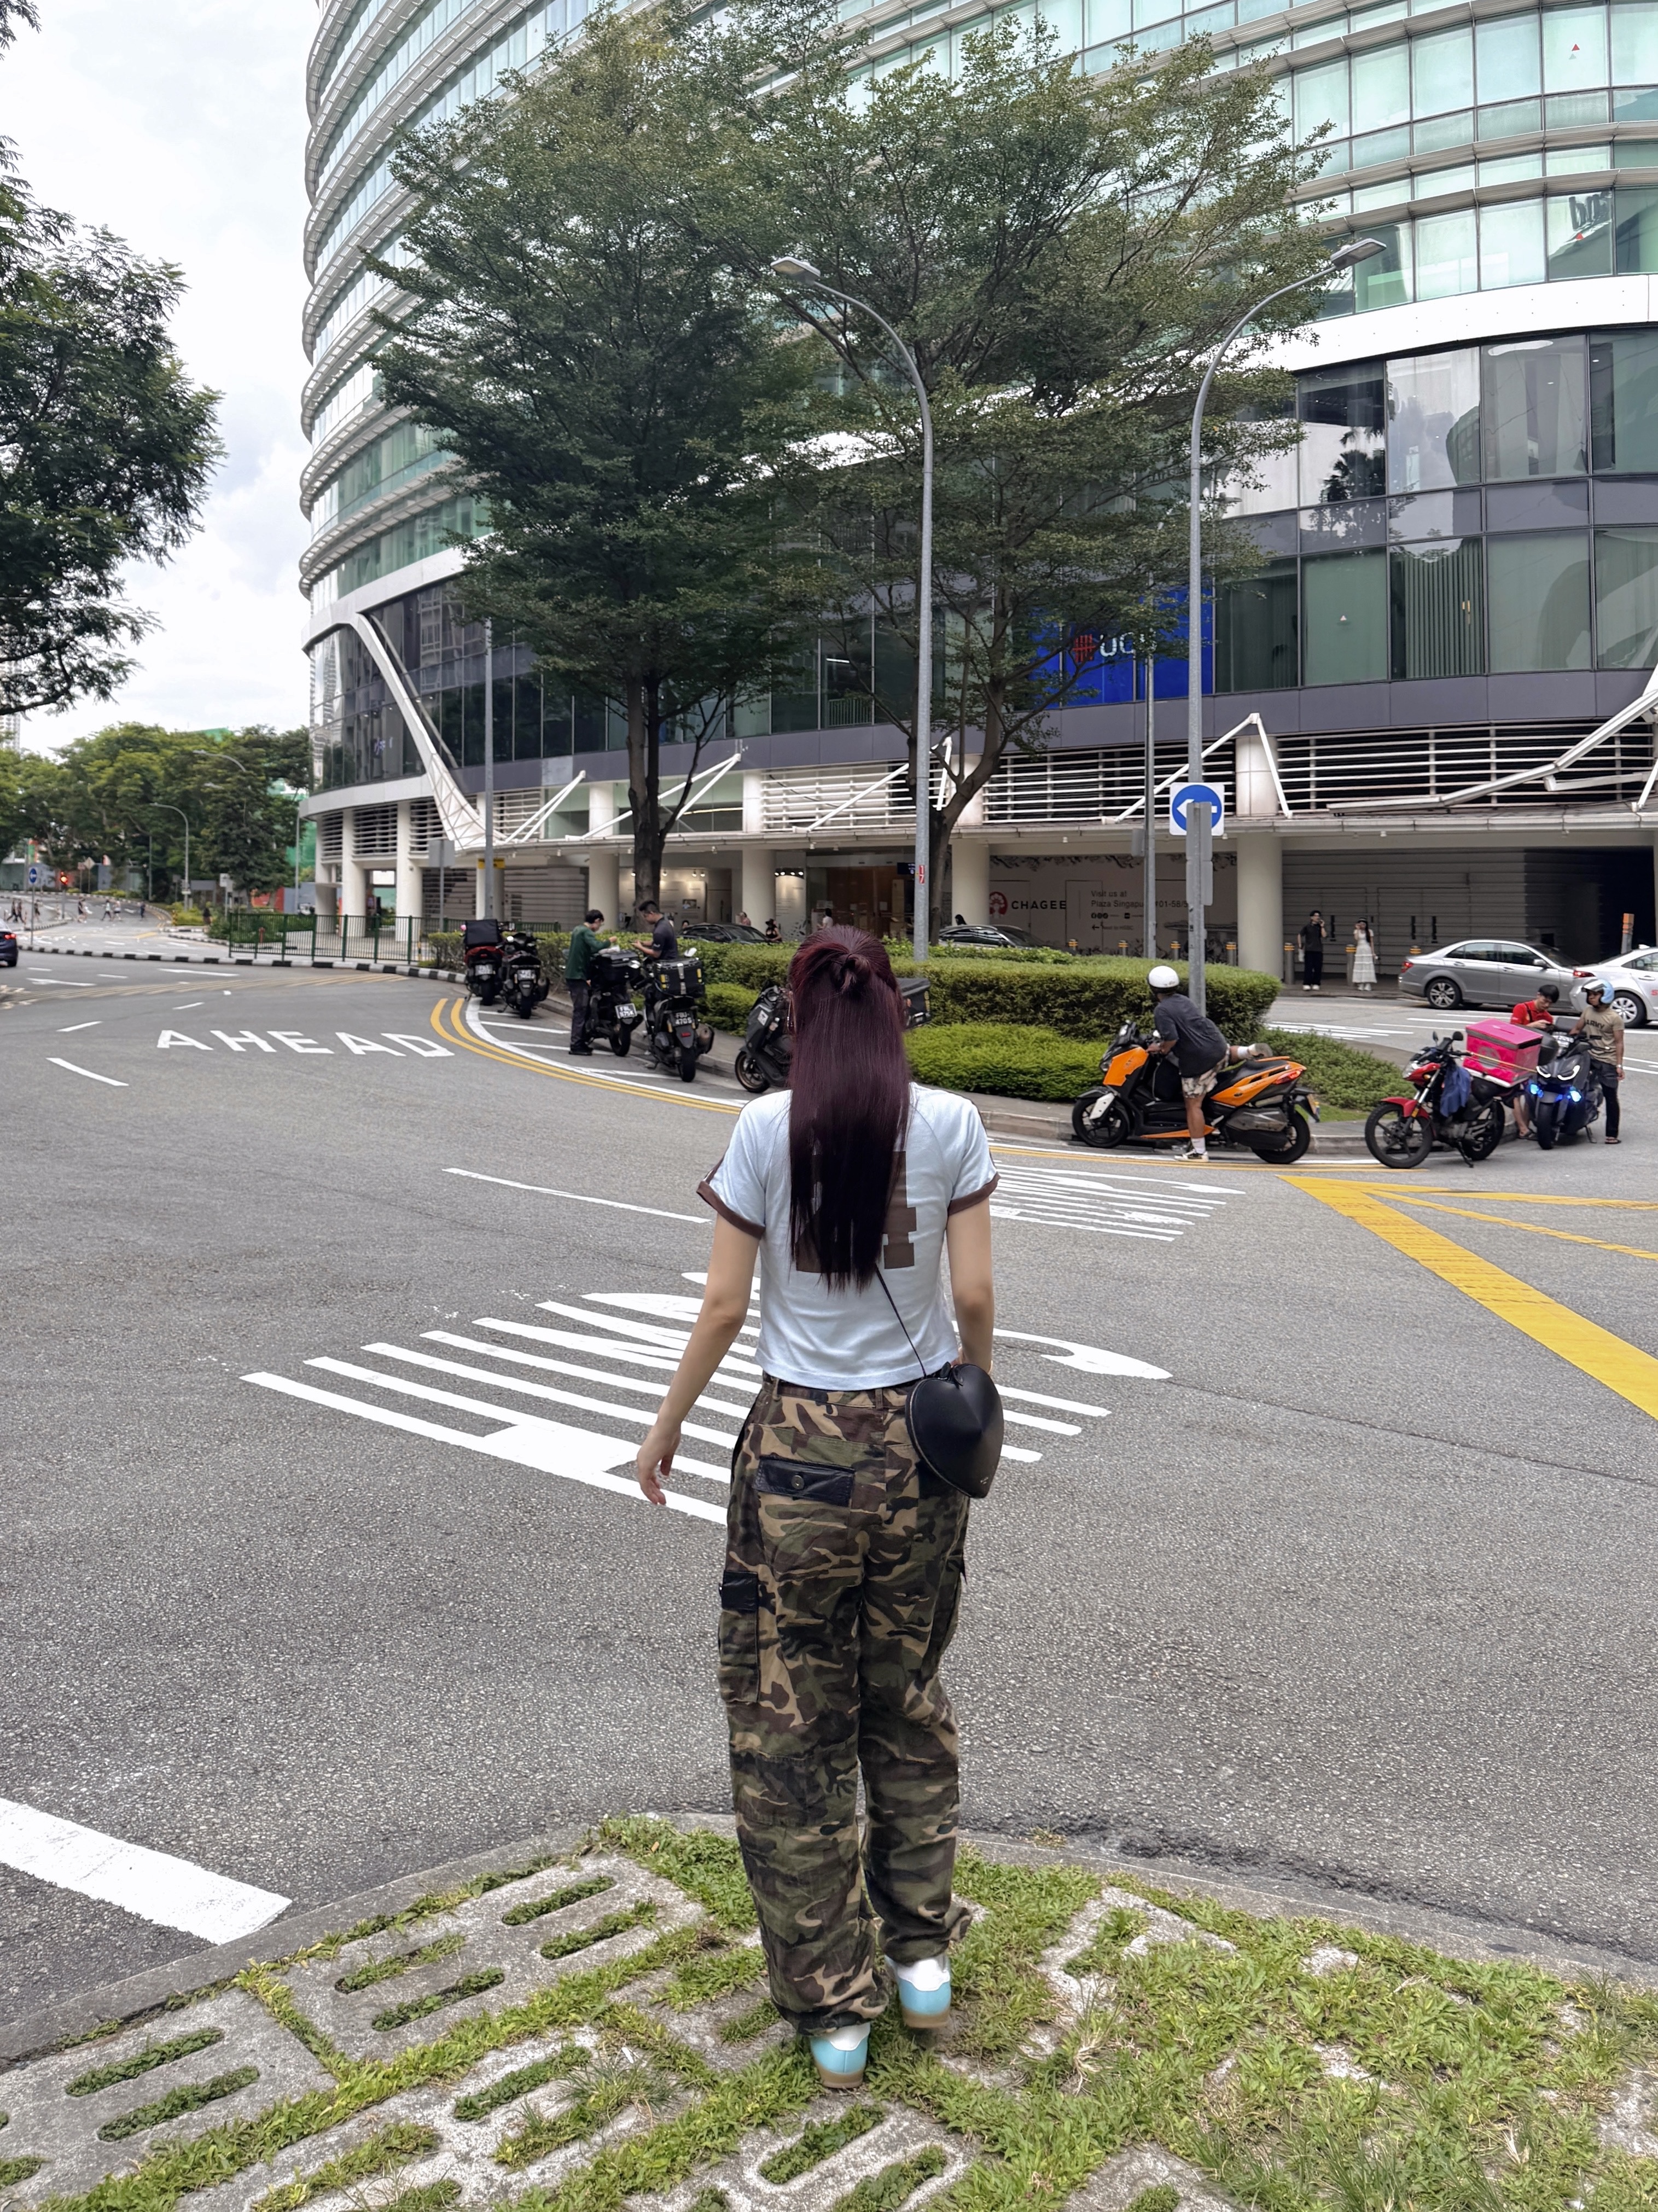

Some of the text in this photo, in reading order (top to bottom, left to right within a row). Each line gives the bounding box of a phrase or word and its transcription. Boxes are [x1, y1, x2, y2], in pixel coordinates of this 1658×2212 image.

[1012, 901, 1066, 909] CHAGEE
[1113, 900, 1144, 909] Singapu
[1586, 1019, 1604, 1029] ARMY
[156, 1030, 455, 1057] AHEAD
